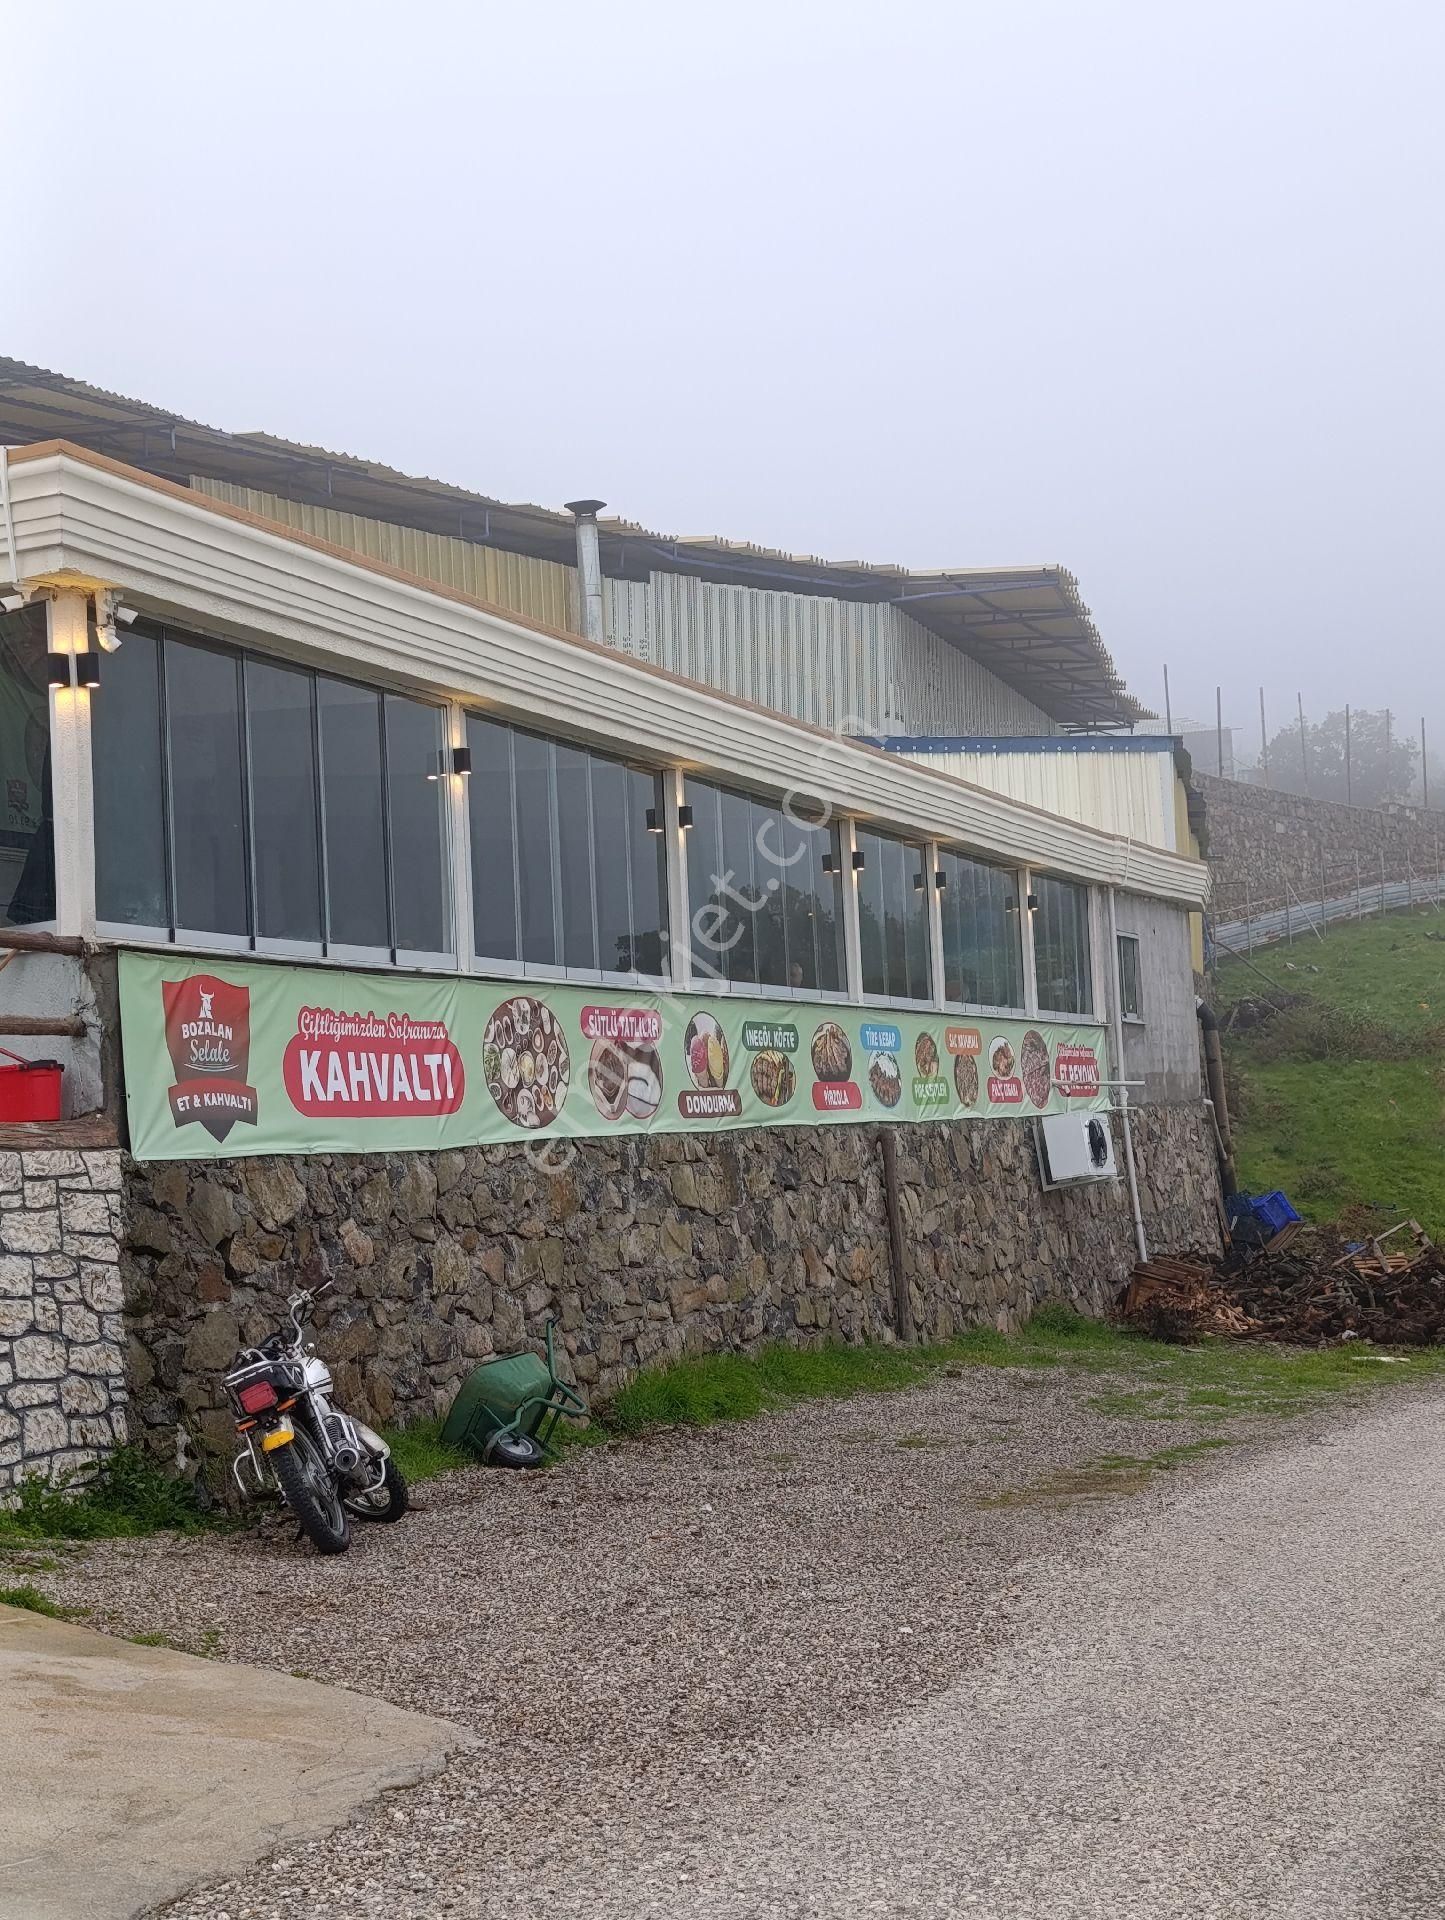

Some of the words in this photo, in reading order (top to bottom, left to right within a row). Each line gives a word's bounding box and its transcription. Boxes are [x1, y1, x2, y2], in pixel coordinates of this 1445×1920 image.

[181, 1021, 233, 1041] BOZALAN
[300, 1011, 387, 1043] Çiftliğimizden
[388, 1017, 446, 1045] Sofranıza
[588, 1010, 617, 1037] SÜTLÜ
[619, 1015, 659, 1038] TATLILAR
[745, 1024, 773, 1047] İNEGÖL
[773, 1027, 795, 1048] KÖFTE
[300, 1049, 455, 1102] KAHVALTI
[176, 1095, 191, 1112] ET
[193, 1095, 202, 1108] &
[204, 1093, 252, 1112] KAHVALTI
[685, 1094, 736, 1114] DONDURMA
[823, 1085, 849, 1106] PİRZOLA
